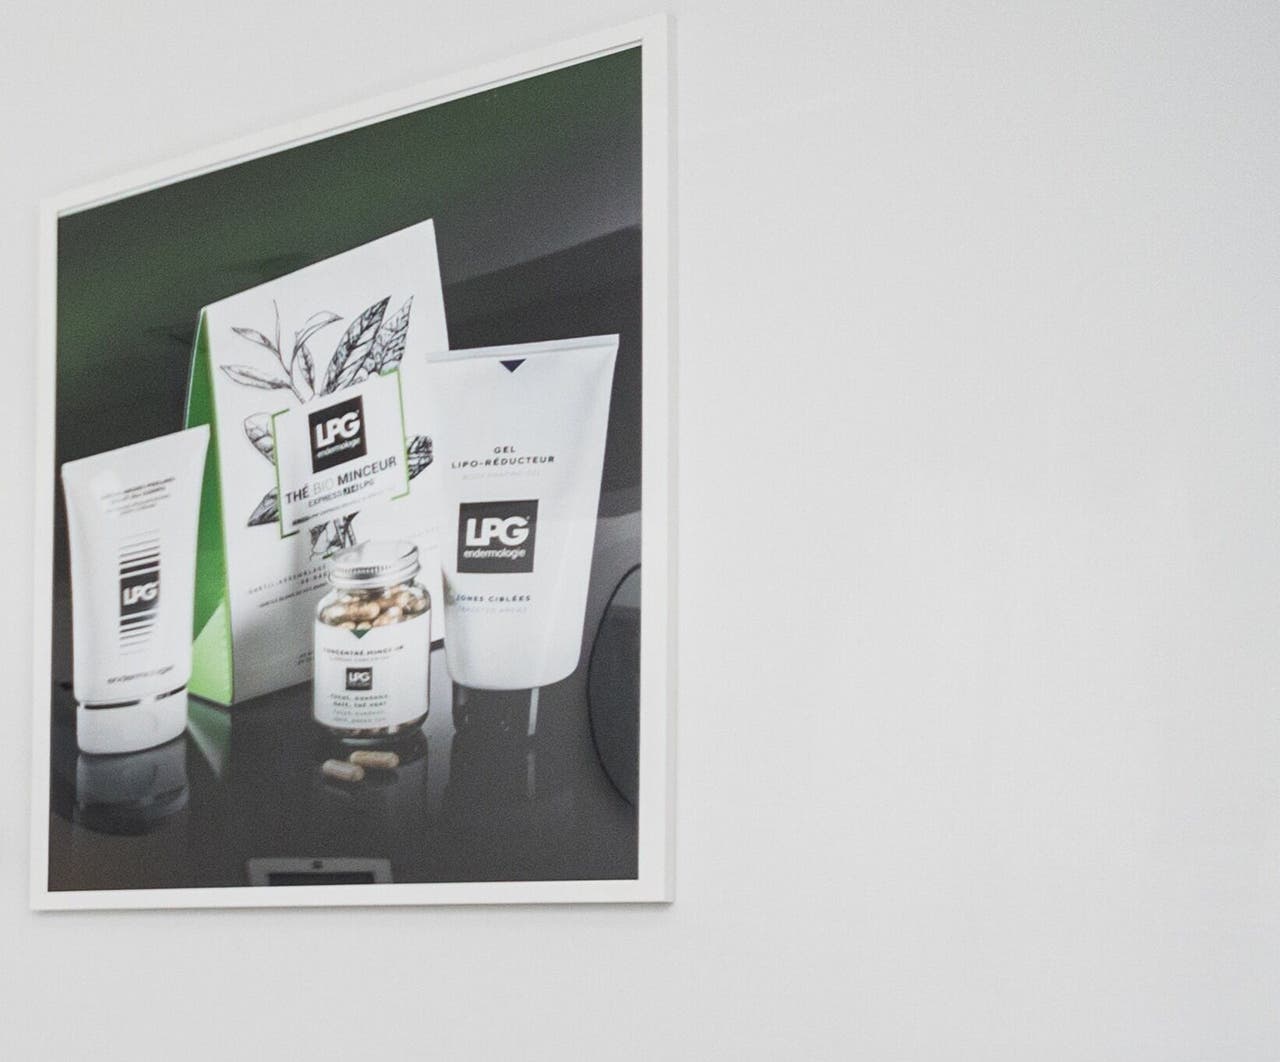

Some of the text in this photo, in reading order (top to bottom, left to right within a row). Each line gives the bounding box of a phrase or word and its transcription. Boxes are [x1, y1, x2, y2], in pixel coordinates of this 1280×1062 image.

[315, 411, 361, 449] LPG
[493, 446, 516, 454] GEL
[451, 455, 555, 469] LIPO-RÉDUCTEUR
[286, 486, 310, 504] THÉ
[337, 456, 397, 486] MINCEUR
[465, 516, 530, 547] LPG
[463, 548, 527, 560] endermologie
[122, 580, 159, 606] LPG
[348, 671, 371, 683] LPG
